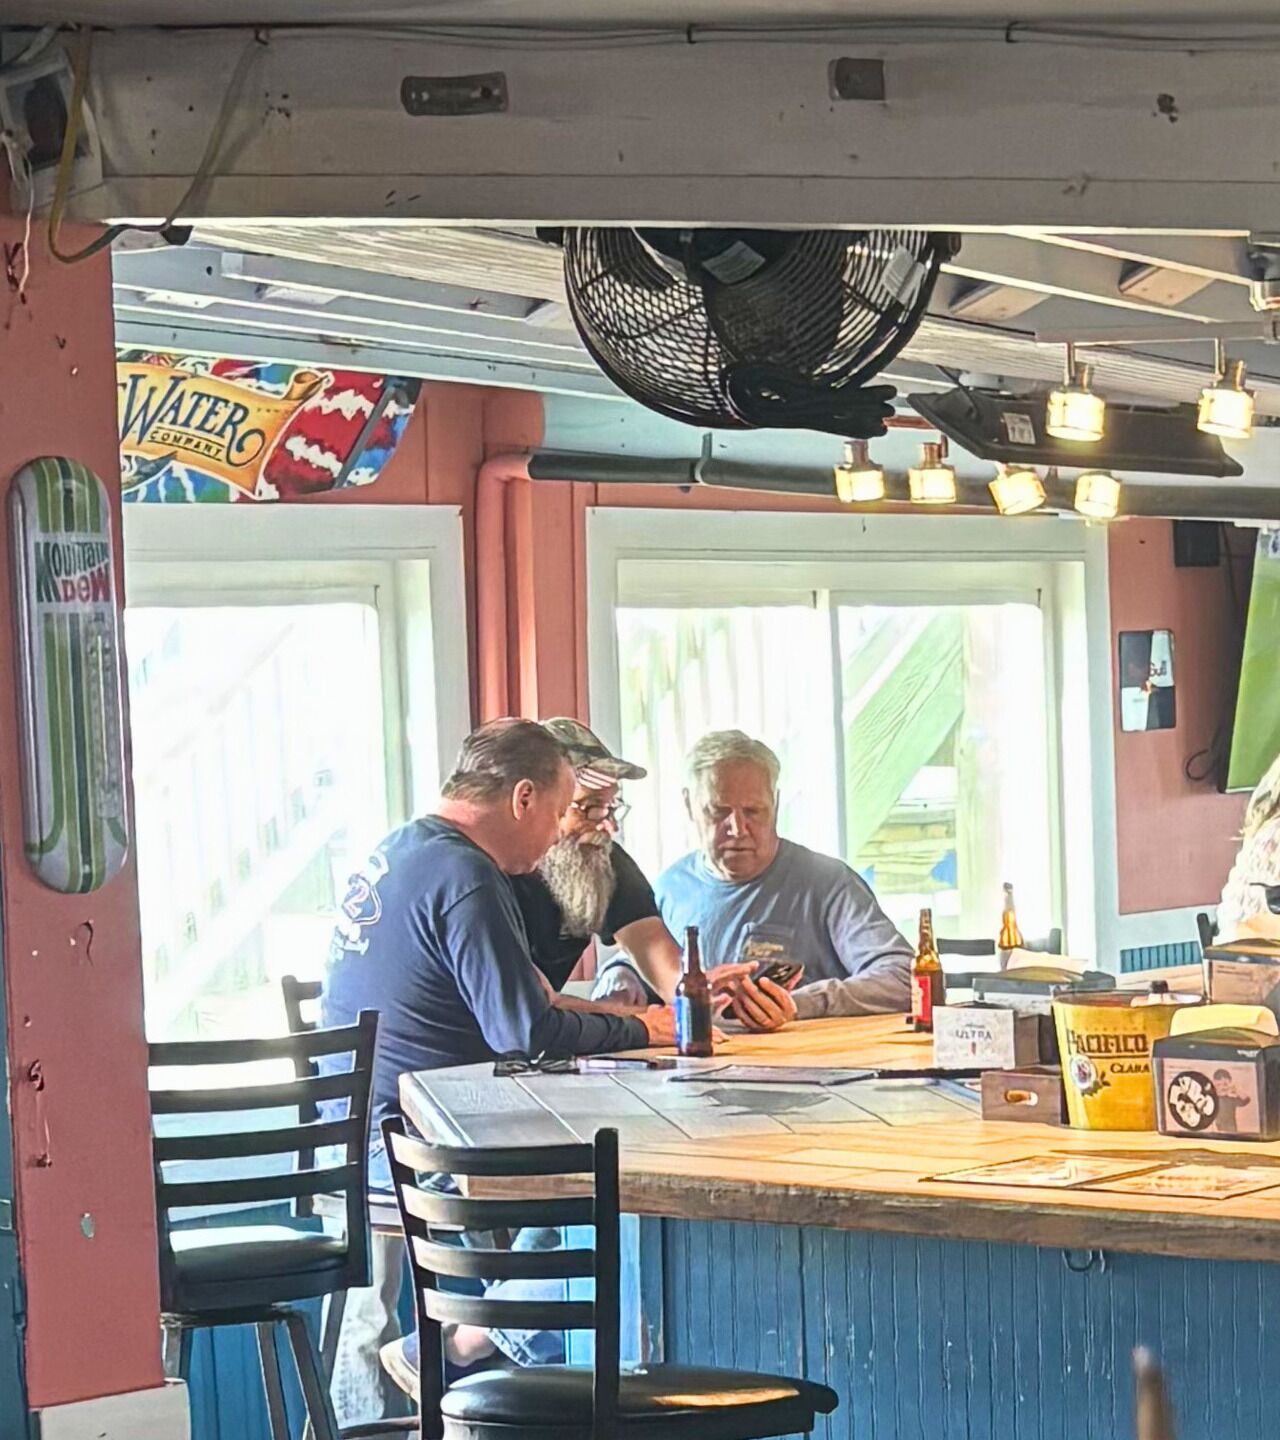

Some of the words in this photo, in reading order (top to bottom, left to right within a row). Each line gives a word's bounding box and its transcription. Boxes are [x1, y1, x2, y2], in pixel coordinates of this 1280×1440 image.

[119, 373, 266, 467] WATER
[150, 430, 224, 456] COMPANY
[955, 1028, 992, 1041] ULTRA
[1066, 1027, 1149, 1055] PACIFICO
[1110, 1062, 1150, 1074] CLARA
